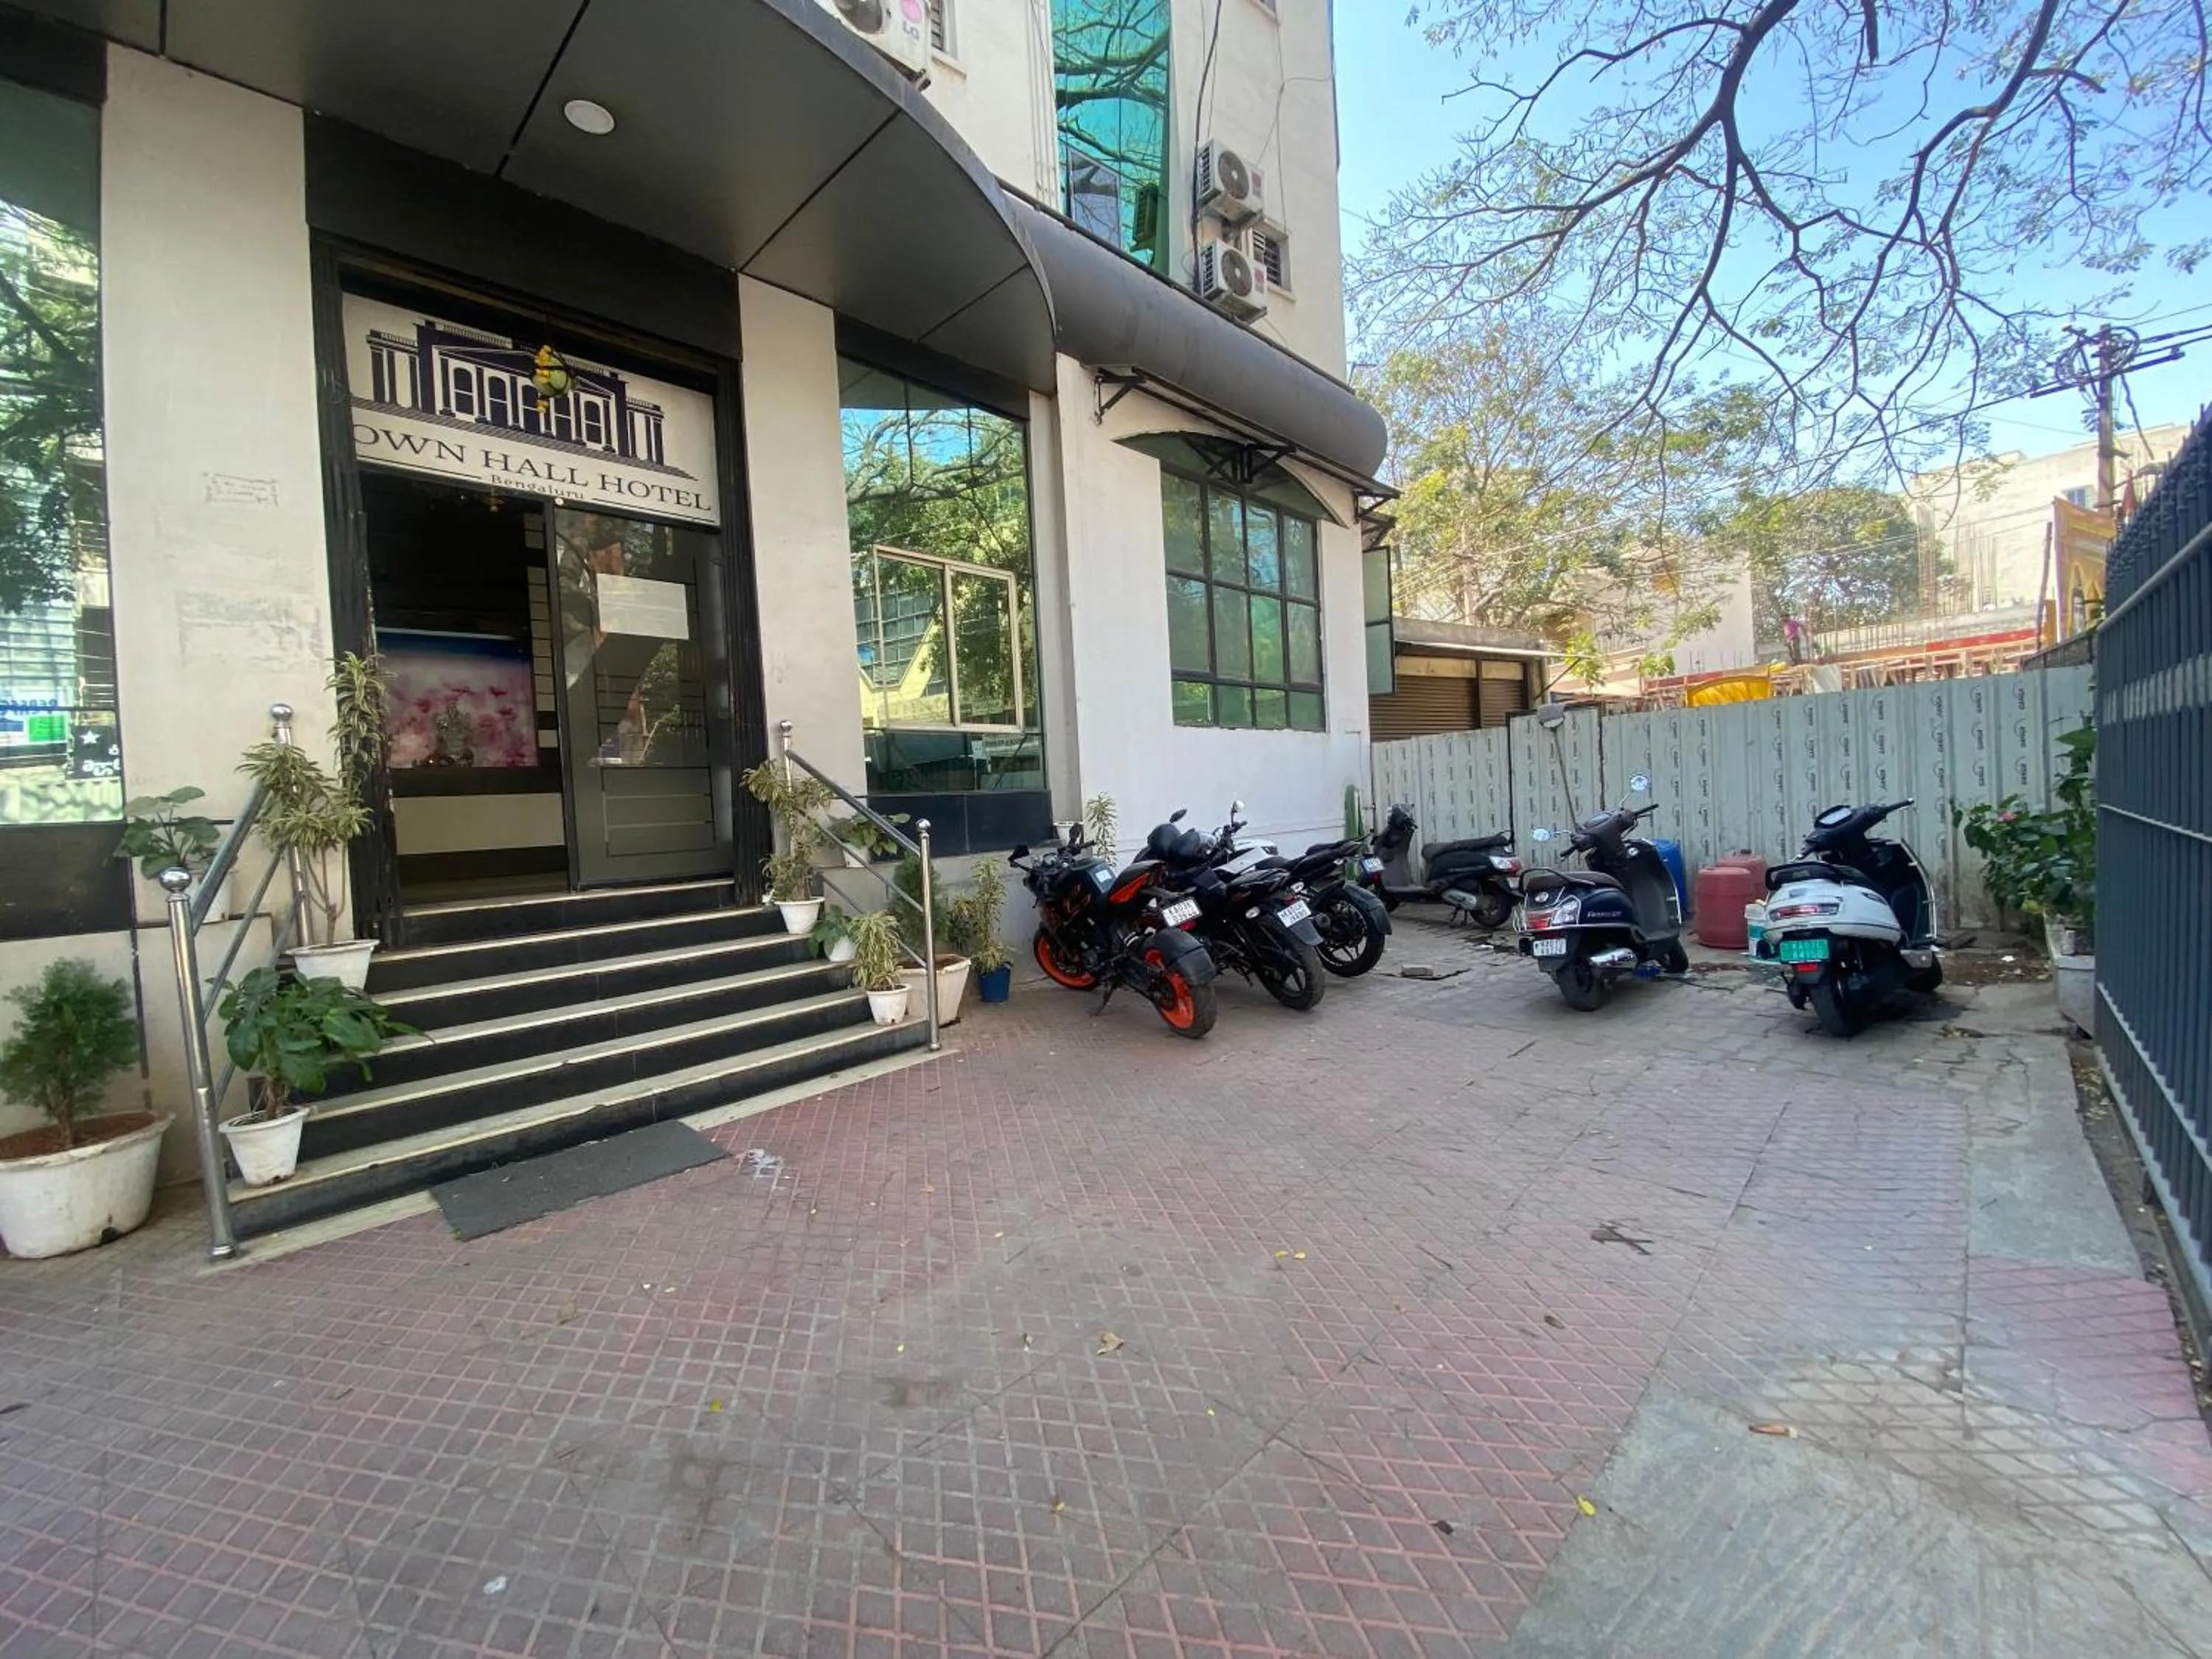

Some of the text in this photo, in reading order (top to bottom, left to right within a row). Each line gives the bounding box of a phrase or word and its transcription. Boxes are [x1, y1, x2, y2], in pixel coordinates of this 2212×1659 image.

[902, 20, 919, 41] LG
[479, 449, 588, 487] HALL
[599, 473, 712, 511] HOTEL
[491, 474, 585, 499] Bengaluru
